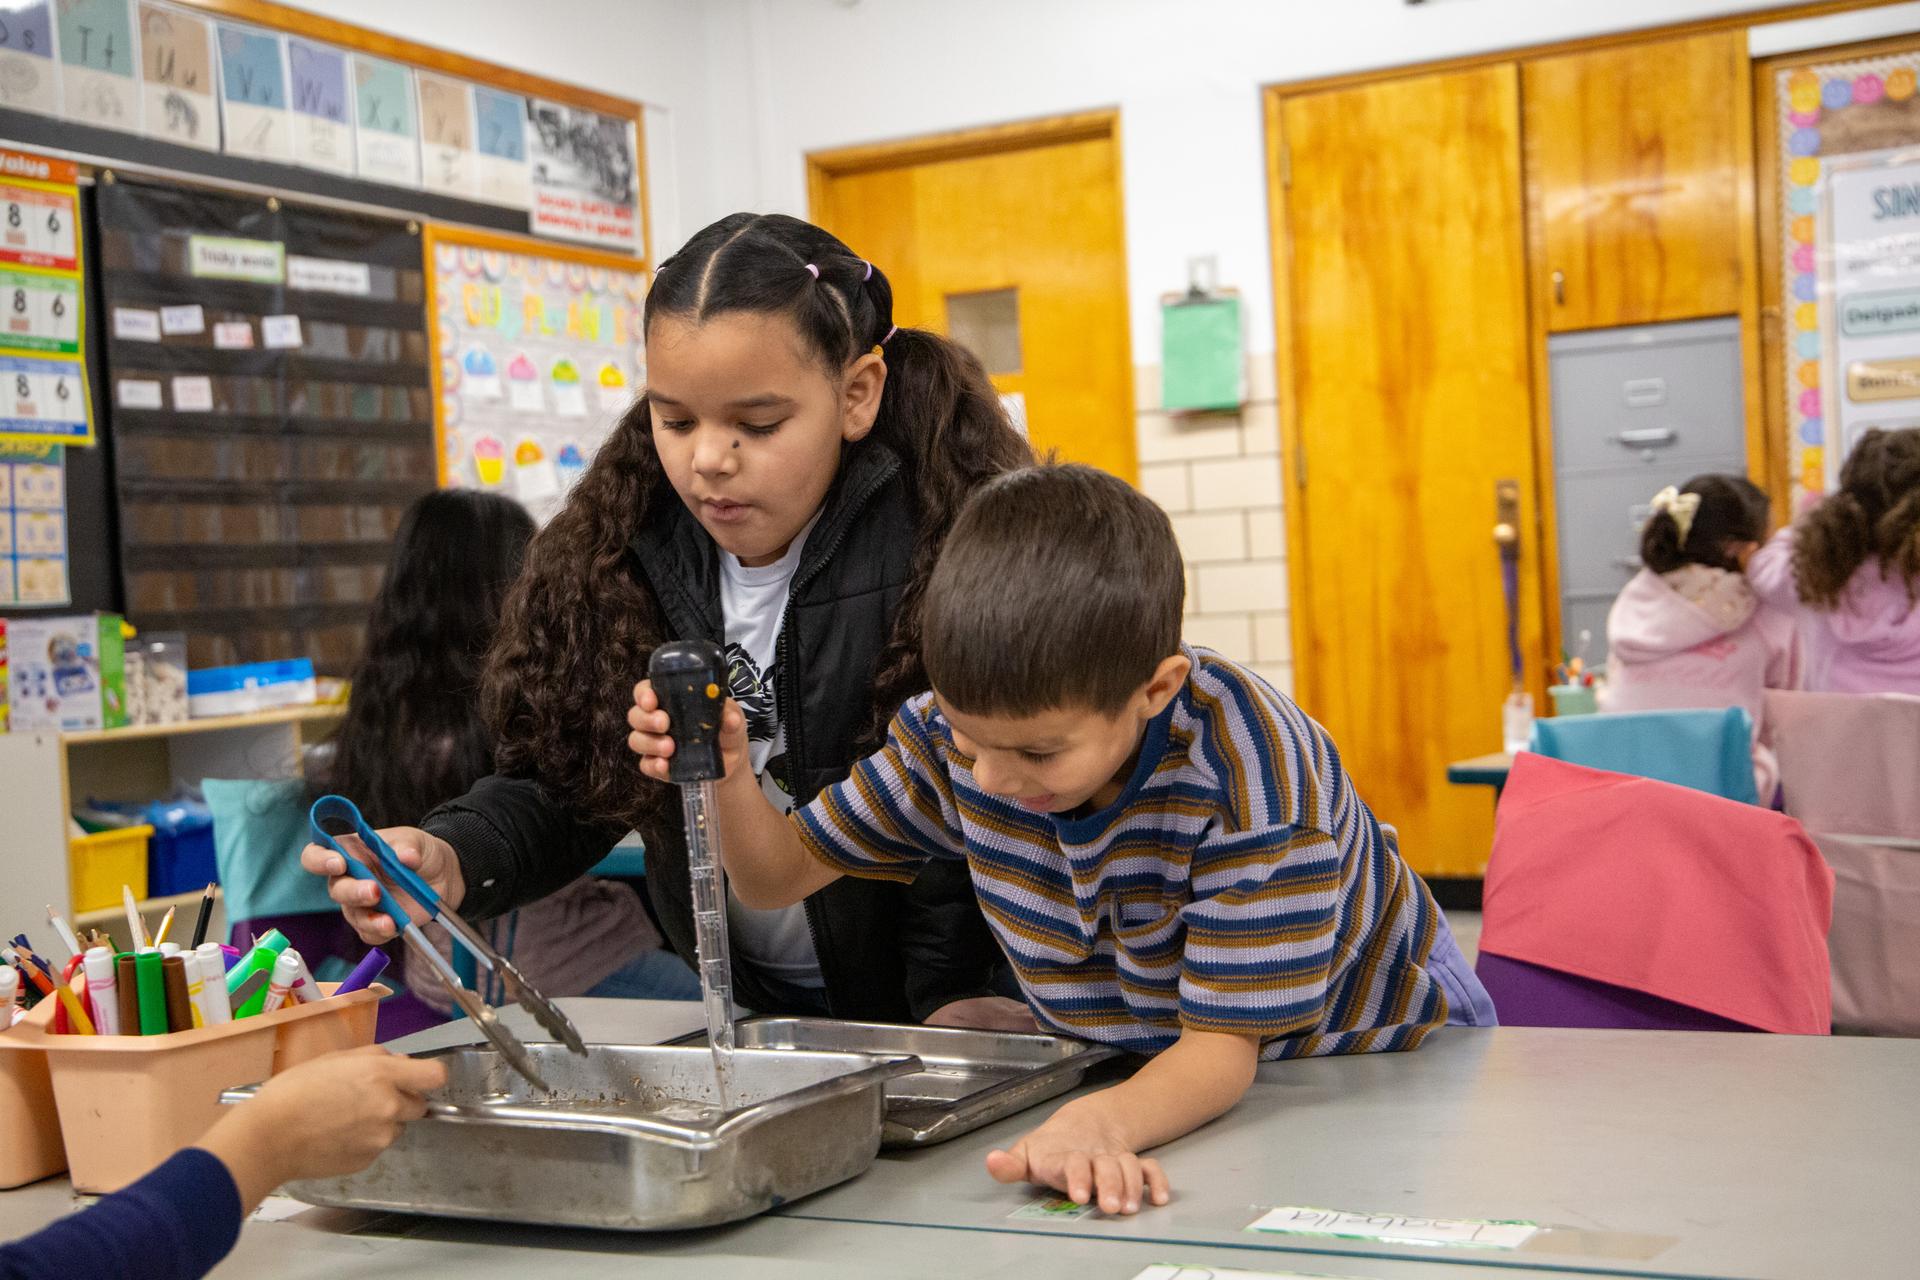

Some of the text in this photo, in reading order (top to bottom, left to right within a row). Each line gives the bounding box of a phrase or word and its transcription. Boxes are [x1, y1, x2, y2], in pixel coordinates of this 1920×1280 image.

[8, 202, 61, 233] 8 6
[14, 288, 65, 318] 8 6
[17, 373, 70, 401] 8 6
